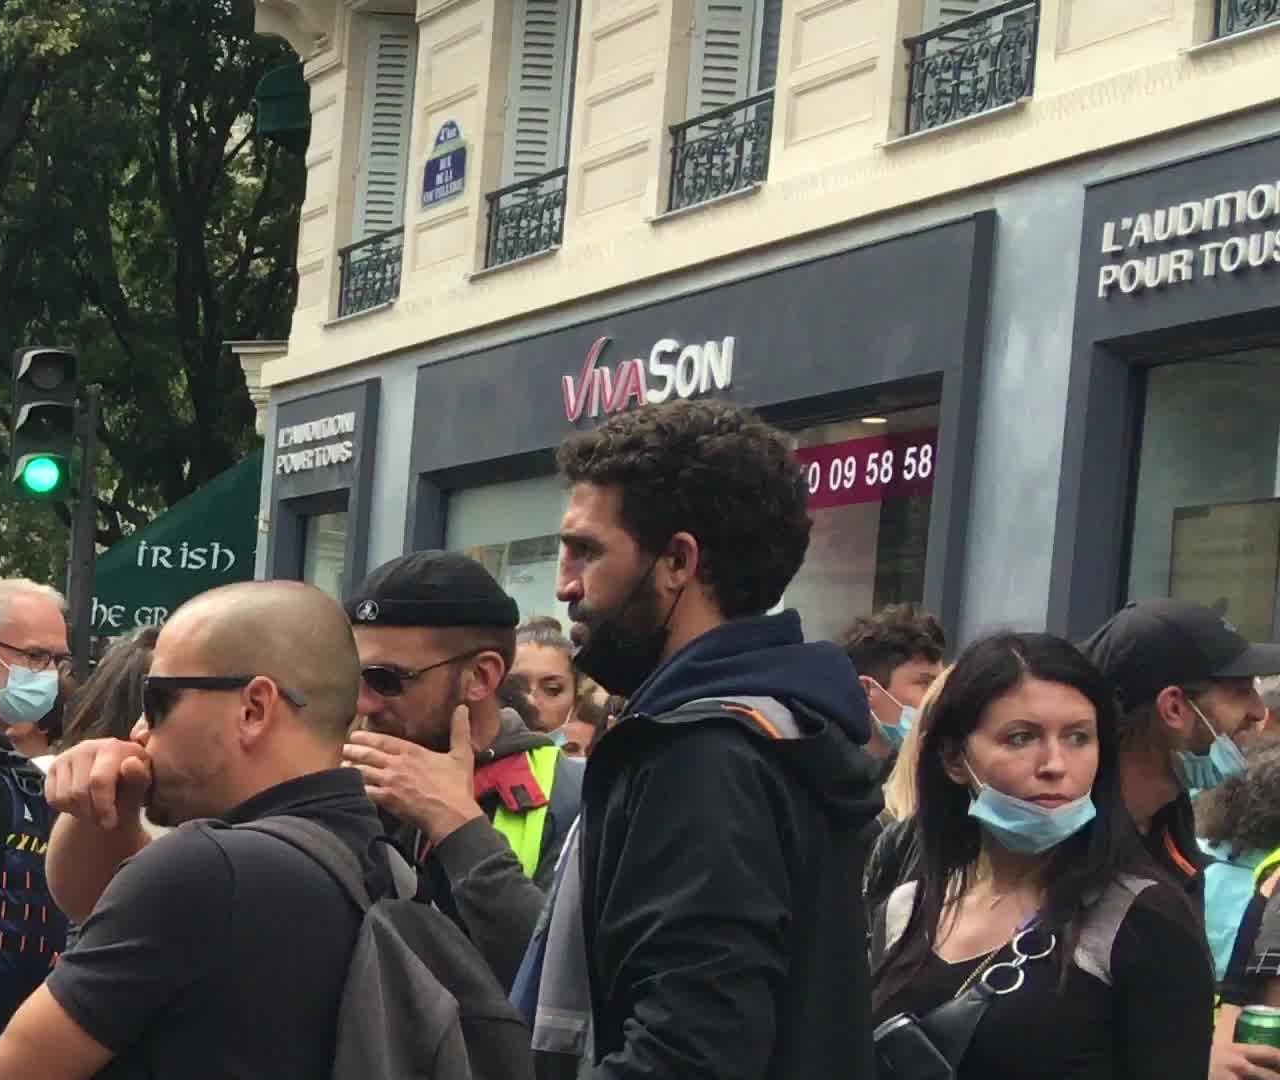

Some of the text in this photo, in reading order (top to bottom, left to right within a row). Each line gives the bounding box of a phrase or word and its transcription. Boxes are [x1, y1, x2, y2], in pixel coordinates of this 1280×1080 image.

[1101, 180, 1280, 254] L'AUDITIO
[1097, 249, 1194, 298] POUR
[800, 443, 933, 495] 0 09 58 58
